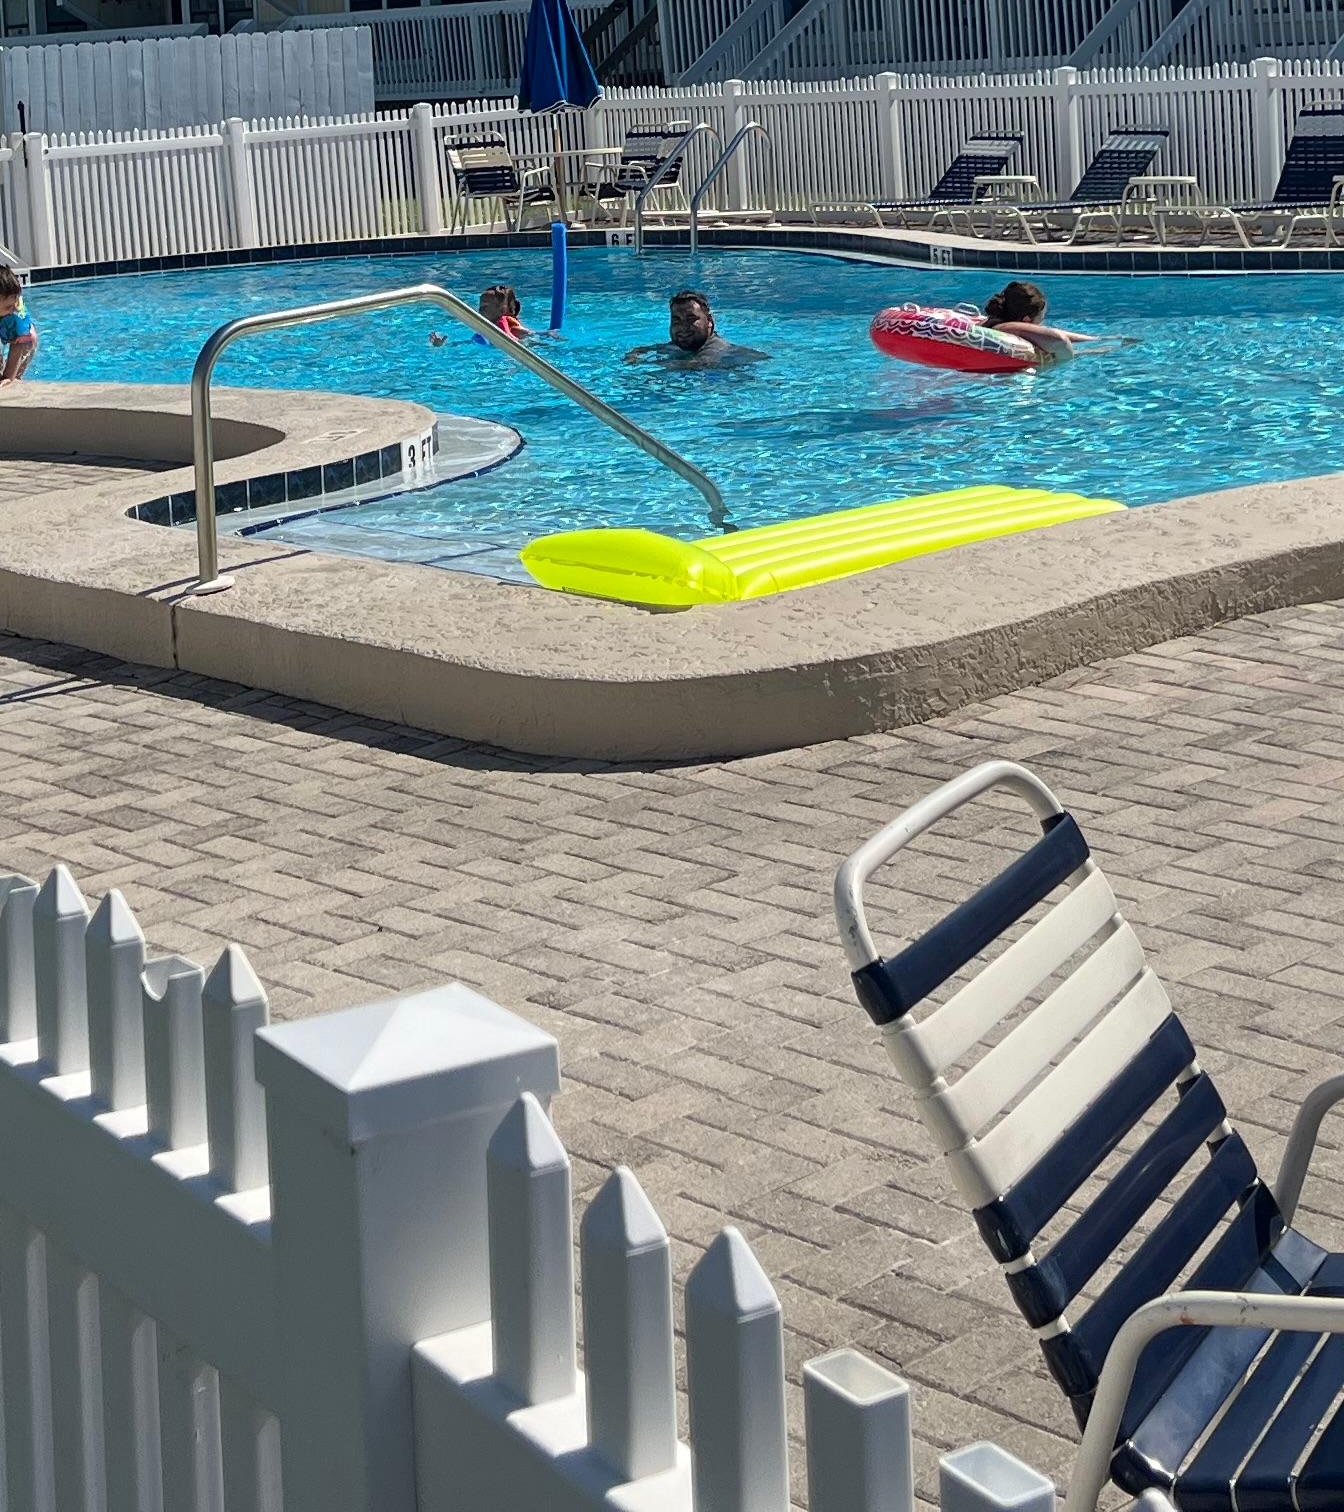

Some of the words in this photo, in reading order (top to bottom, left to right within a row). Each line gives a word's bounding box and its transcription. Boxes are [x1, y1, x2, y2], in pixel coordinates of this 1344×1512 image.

[611, 233, 620, 246] 6
[408, 444, 416, 469] 3
[421, 435, 432, 462] FT
